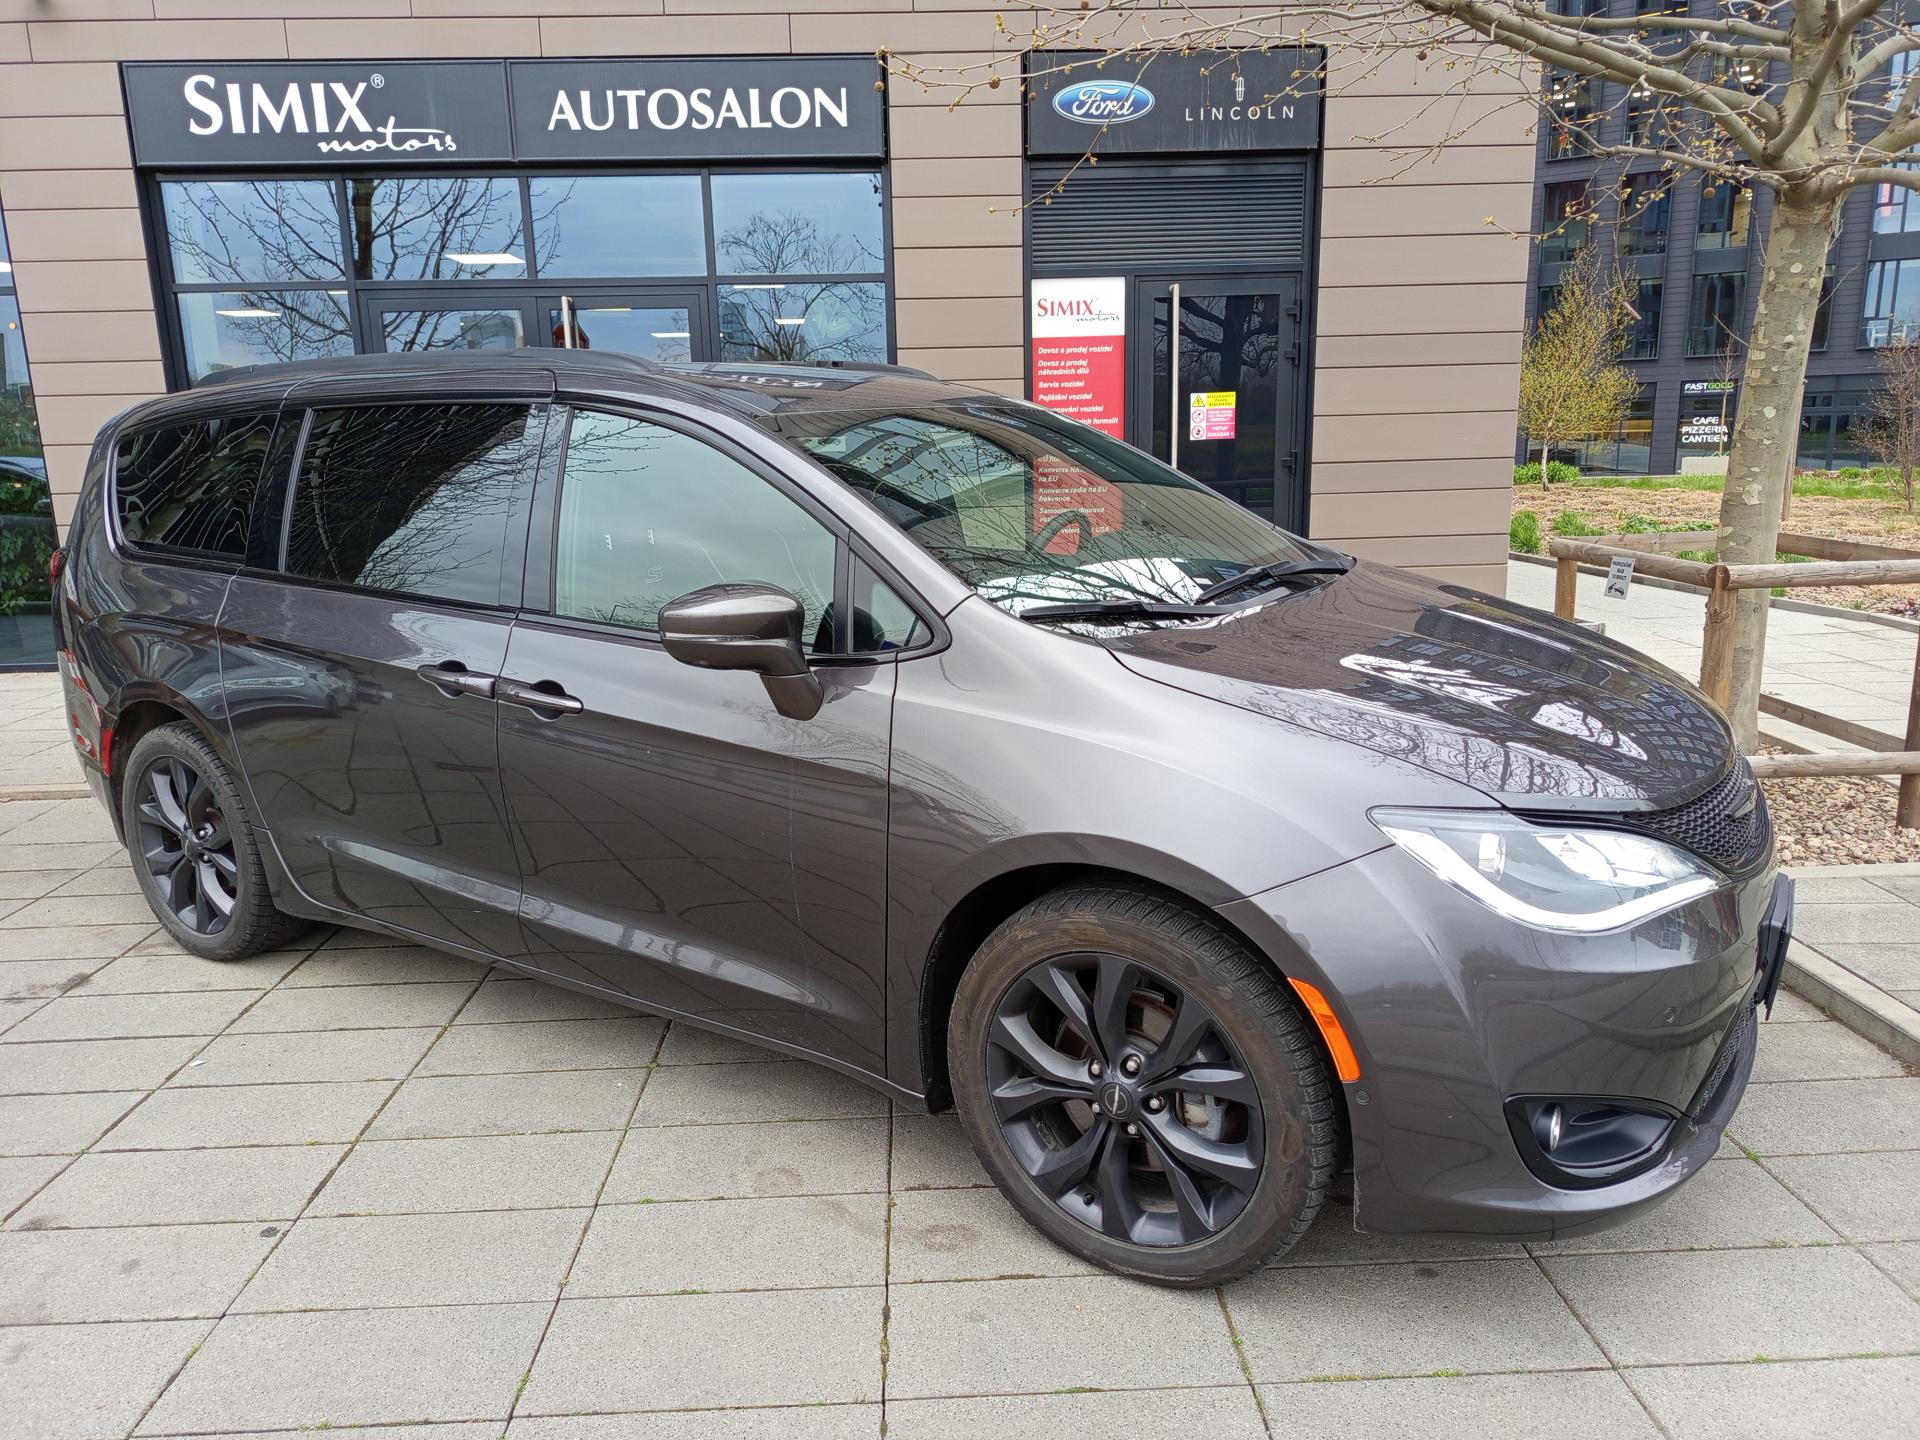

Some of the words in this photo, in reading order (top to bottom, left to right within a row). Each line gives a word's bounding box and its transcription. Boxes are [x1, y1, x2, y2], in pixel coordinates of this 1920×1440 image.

[1071, 87, 1135, 116] Ford
[548, 87, 848, 131] AUTOSALON
[1185, 105, 1295, 121] LINCOLN
[318, 115, 457, 153] motors
[1037, 298, 1094, 317] SIMIX
[1066, 346, 1088, 355] prodej
[1089, 345, 1113, 353] vozidel
[1066, 359, 1089, 367] prodej
[1038, 368, 1076, 376] náhradních
[1693, 416, 1719, 424] CAFE
[1681, 425, 1728, 434] PIZZERIA
[1681, 434, 1728, 443] CANTEEN
